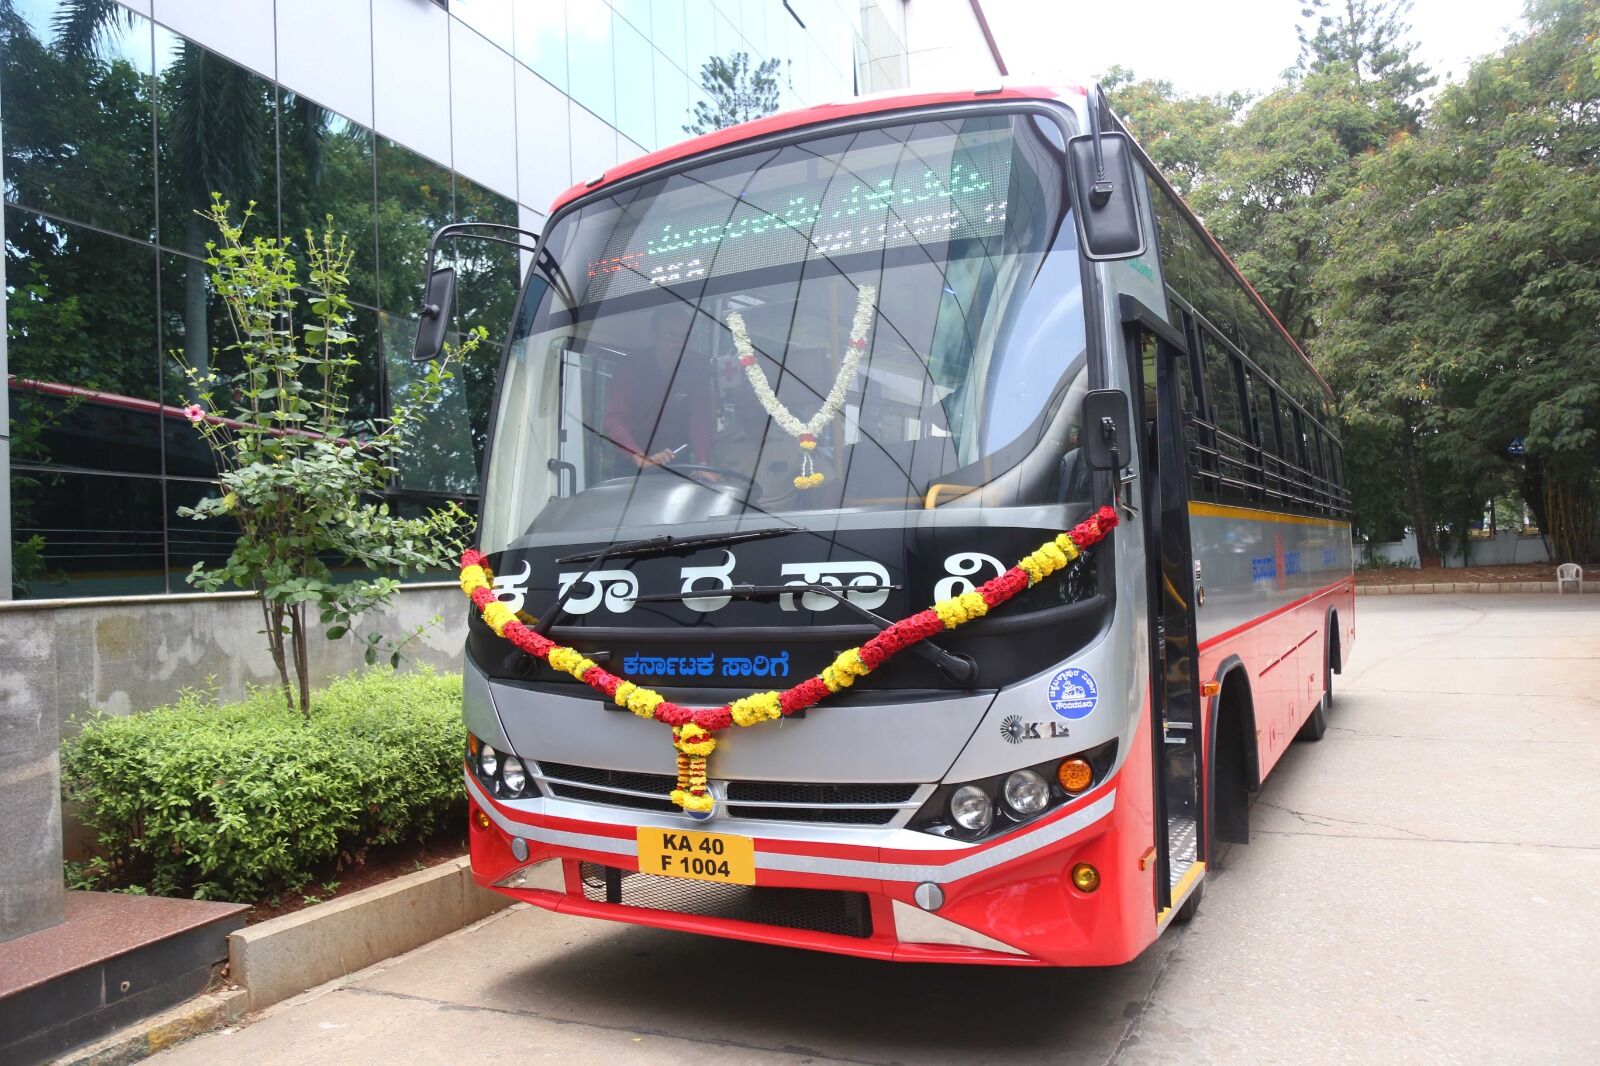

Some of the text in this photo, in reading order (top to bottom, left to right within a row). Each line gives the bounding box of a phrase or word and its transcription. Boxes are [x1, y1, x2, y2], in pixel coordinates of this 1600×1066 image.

[623, 651, 789, 677] ಕರ್ನಾಟಕ ಸಾರಿಗೆ
[663, 833, 724, 855] KA 40
[661, 855, 730, 877] F 1004
